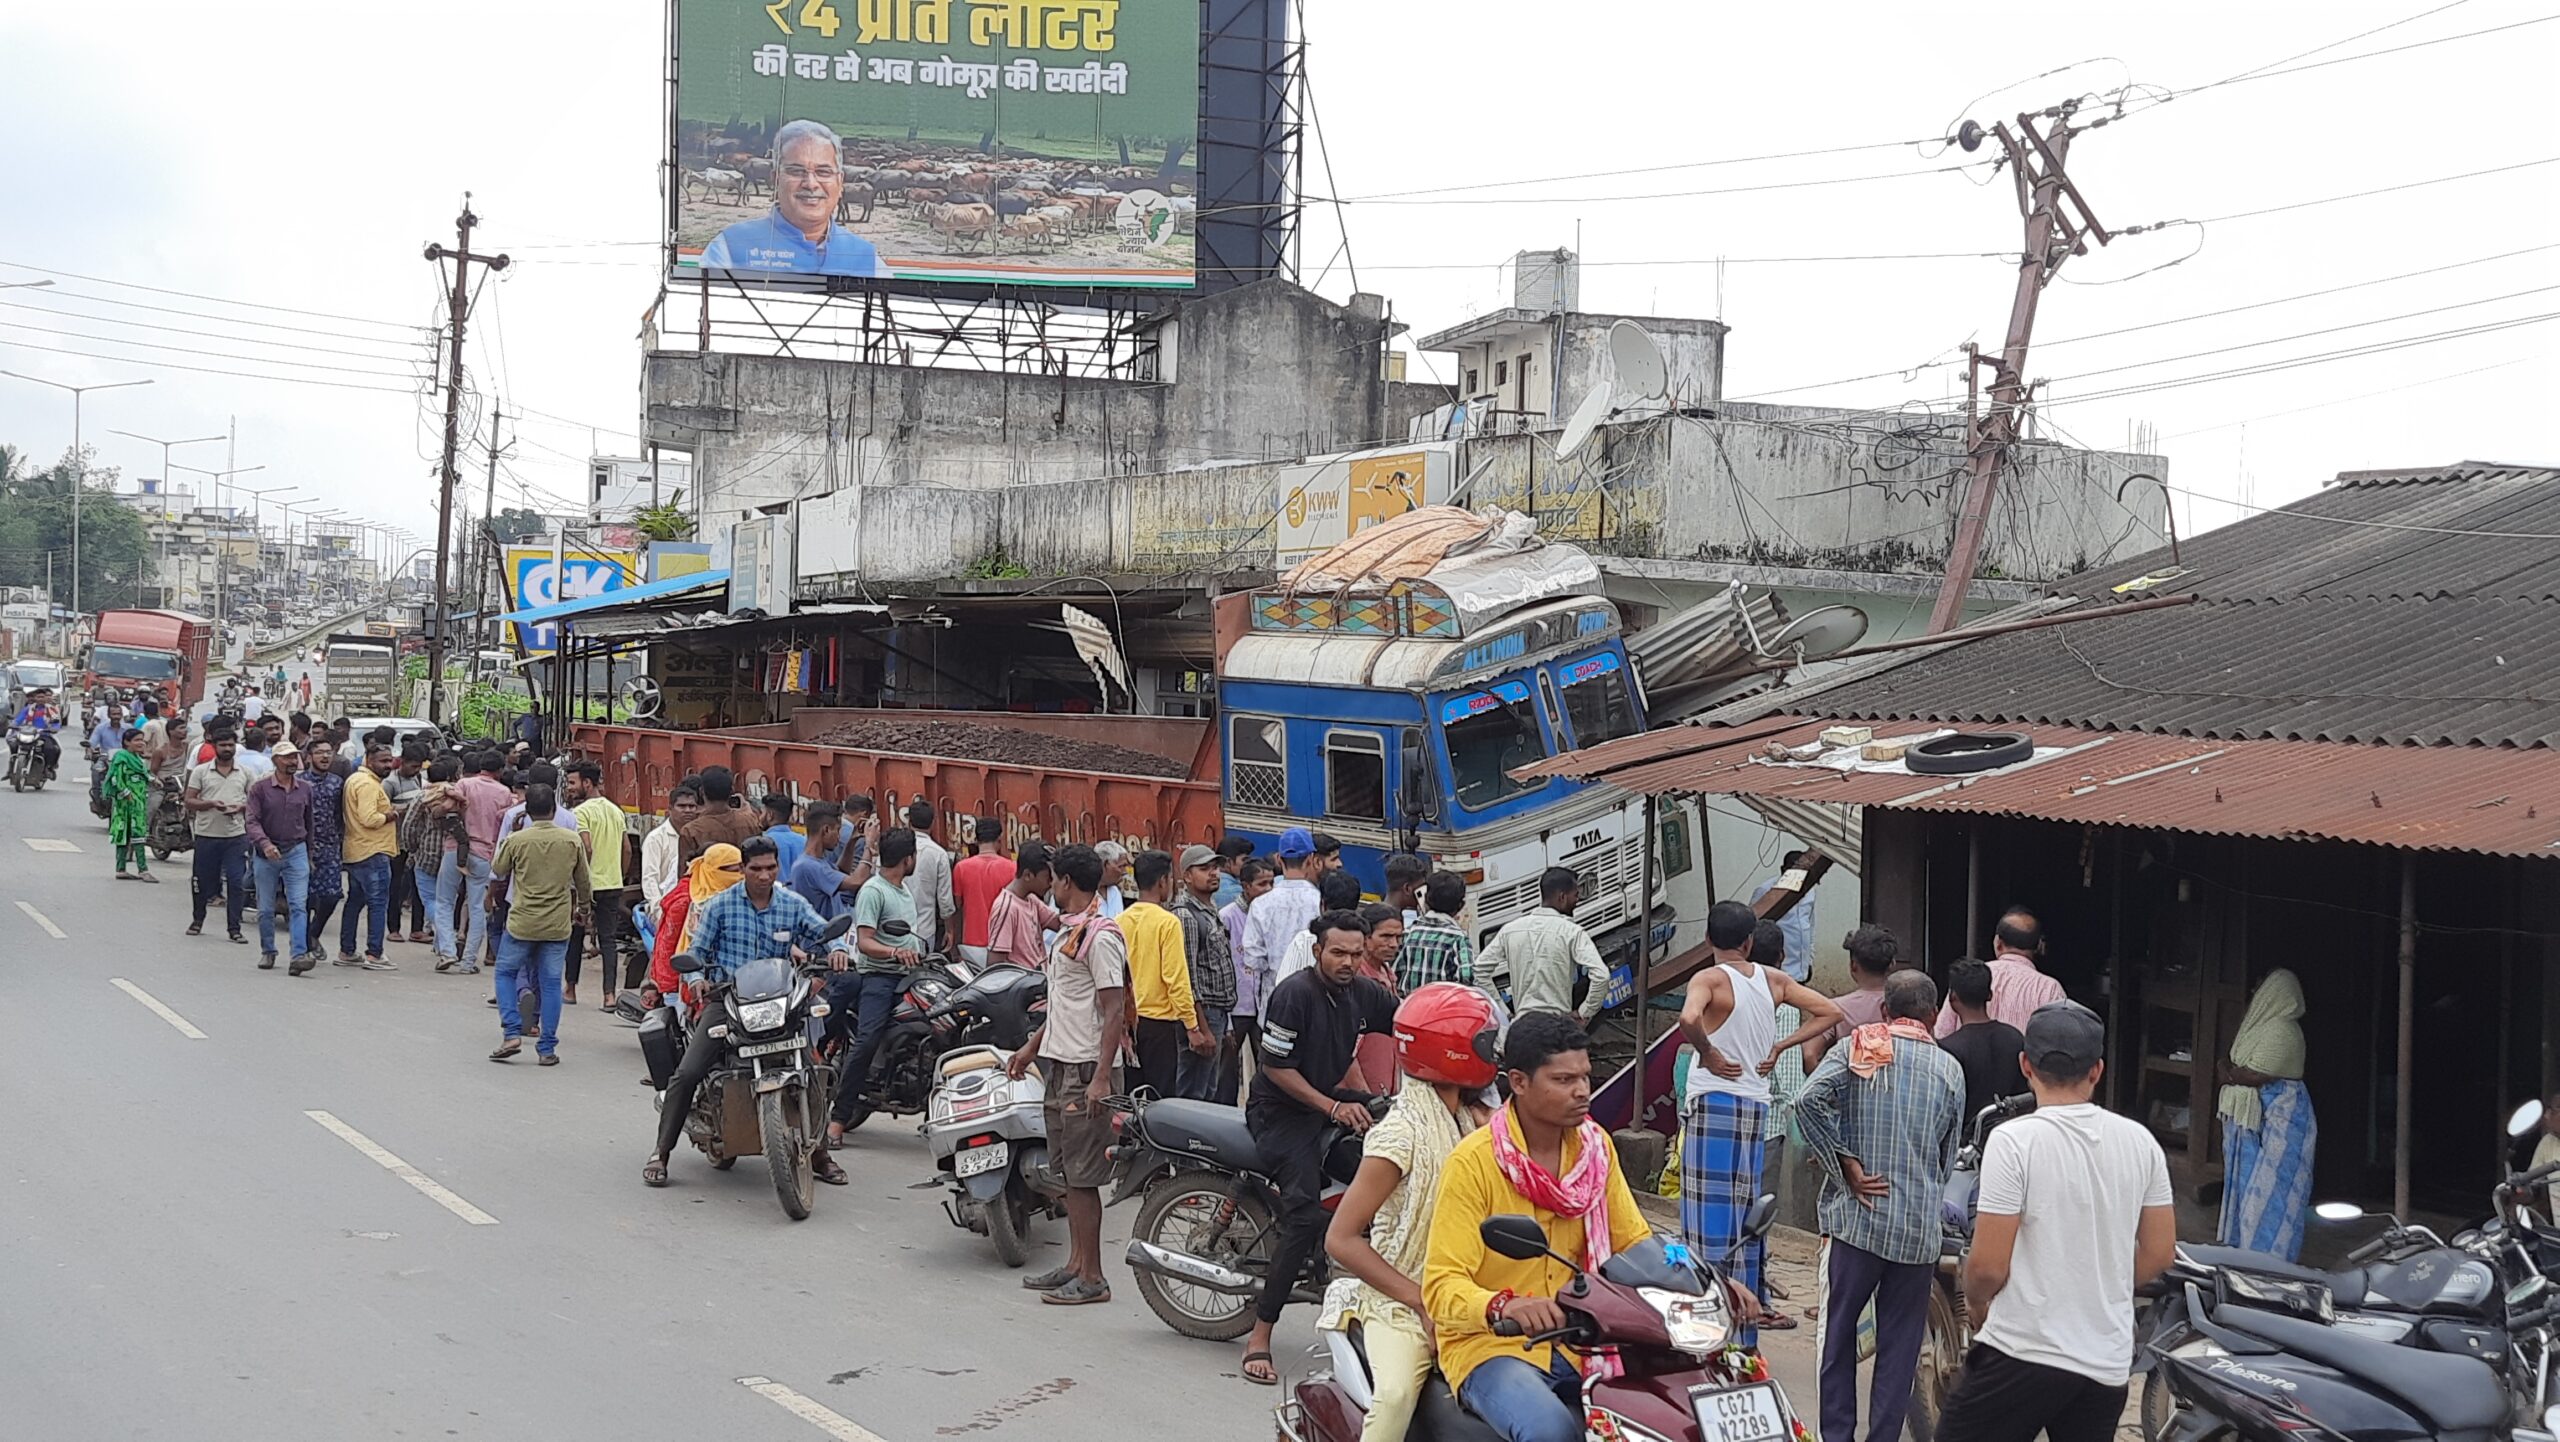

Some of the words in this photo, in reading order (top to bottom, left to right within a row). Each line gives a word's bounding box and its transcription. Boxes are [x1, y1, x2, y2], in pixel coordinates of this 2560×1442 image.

[753, 44, 789, 77] की
[793, 53, 830, 80] दर
[834, 49, 861, 82] से
[867, 58, 914, 85] अब
[918, 54, 999, 99] गोमूत्र
[1003, 58, 1039, 92] की
[1044, 61, 1128, 95] खरीदी
[1308, 489, 1340, 512] KWW
[1462, 645, 1489, 672] ALL
[1491, 630, 1526, 665] INDIA
[1572, 828, 1602, 849] TATA
[2207, 1357, 2298, 1391] Pleasure
[1716, 1391, 1756, 1418] CG27
[1717, 1414, 1770, 1442] N2289
